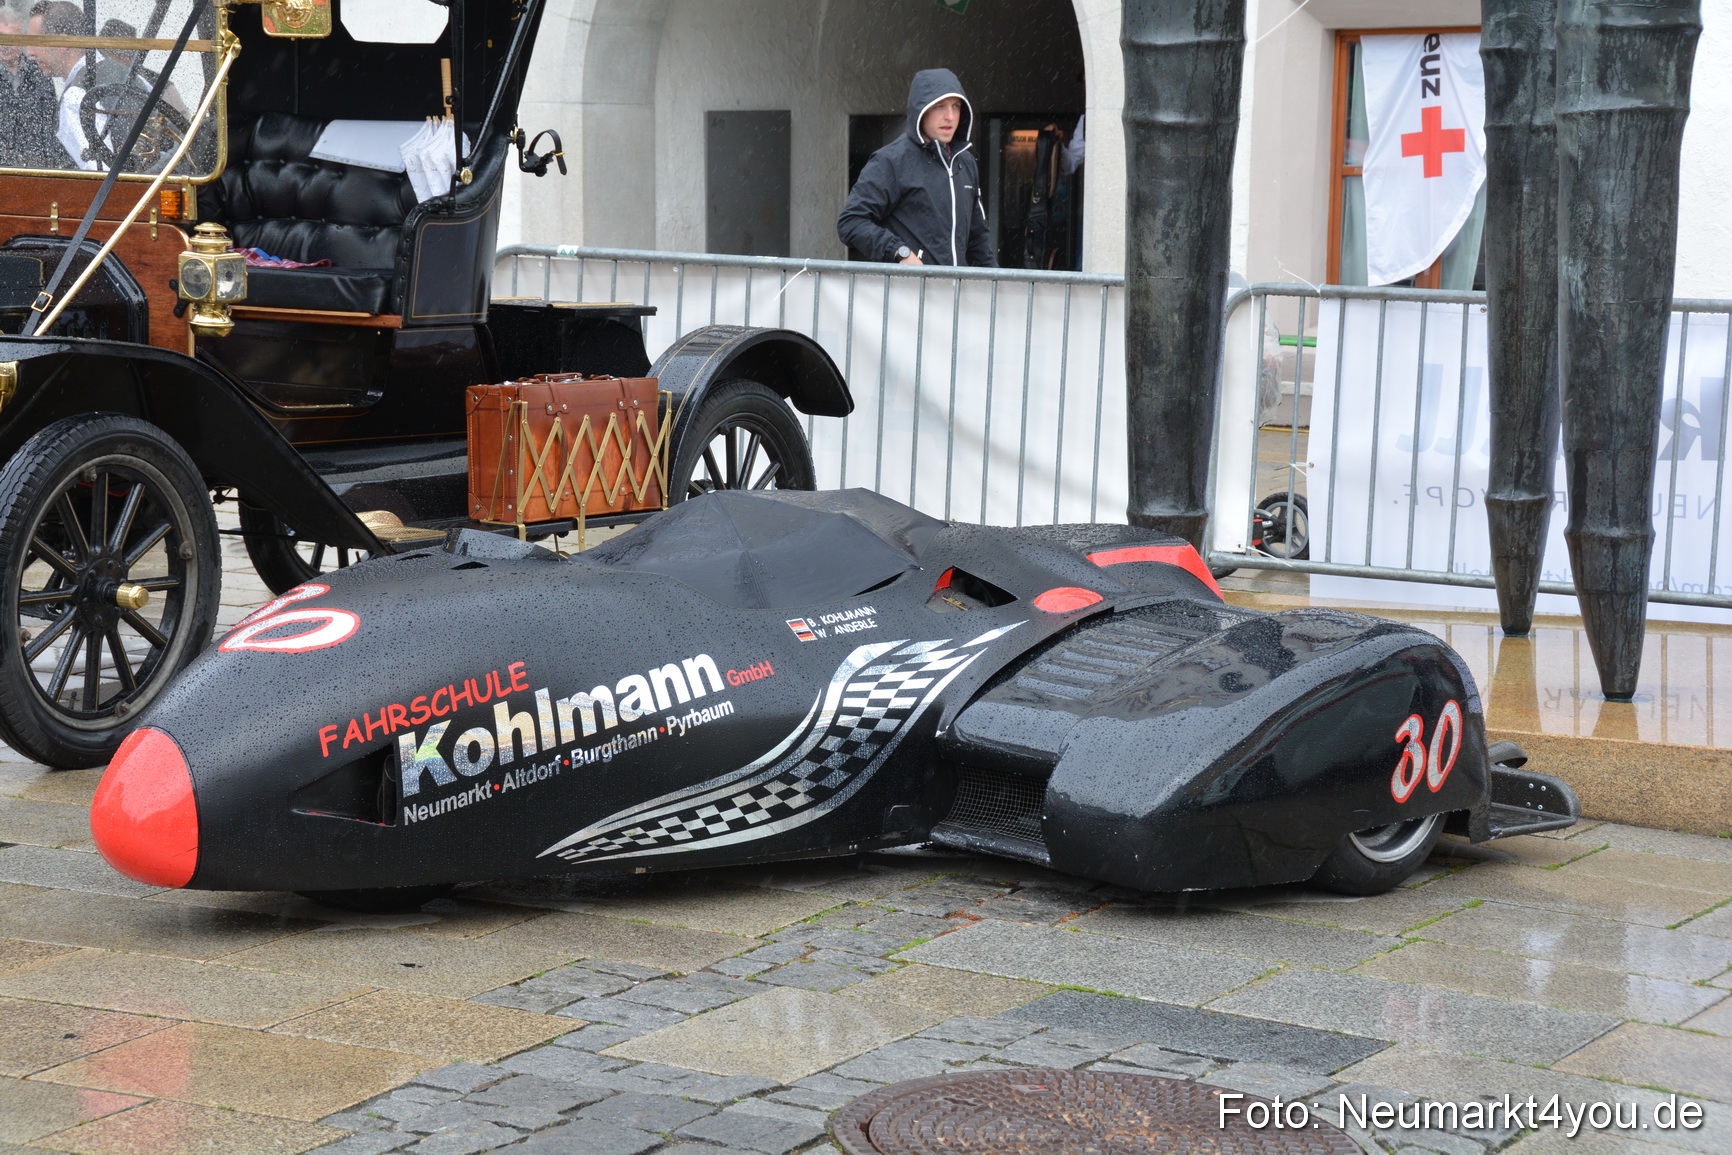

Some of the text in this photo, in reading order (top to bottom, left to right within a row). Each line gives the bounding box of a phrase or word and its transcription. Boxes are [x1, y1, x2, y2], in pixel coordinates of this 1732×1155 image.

[807, 606, 877, 627] B. KOHLMANN
[834, 618, 878, 634] ANDERLE
[318, 661, 529, 758] FAHRSCHULE
[397, 653, 775, 798] Kohlmann GmbH
[1391, 699, 1462, 803] 30
[403, 699, 735, 826] Neumarkt Altdorf Burgthann Pyrbaum
